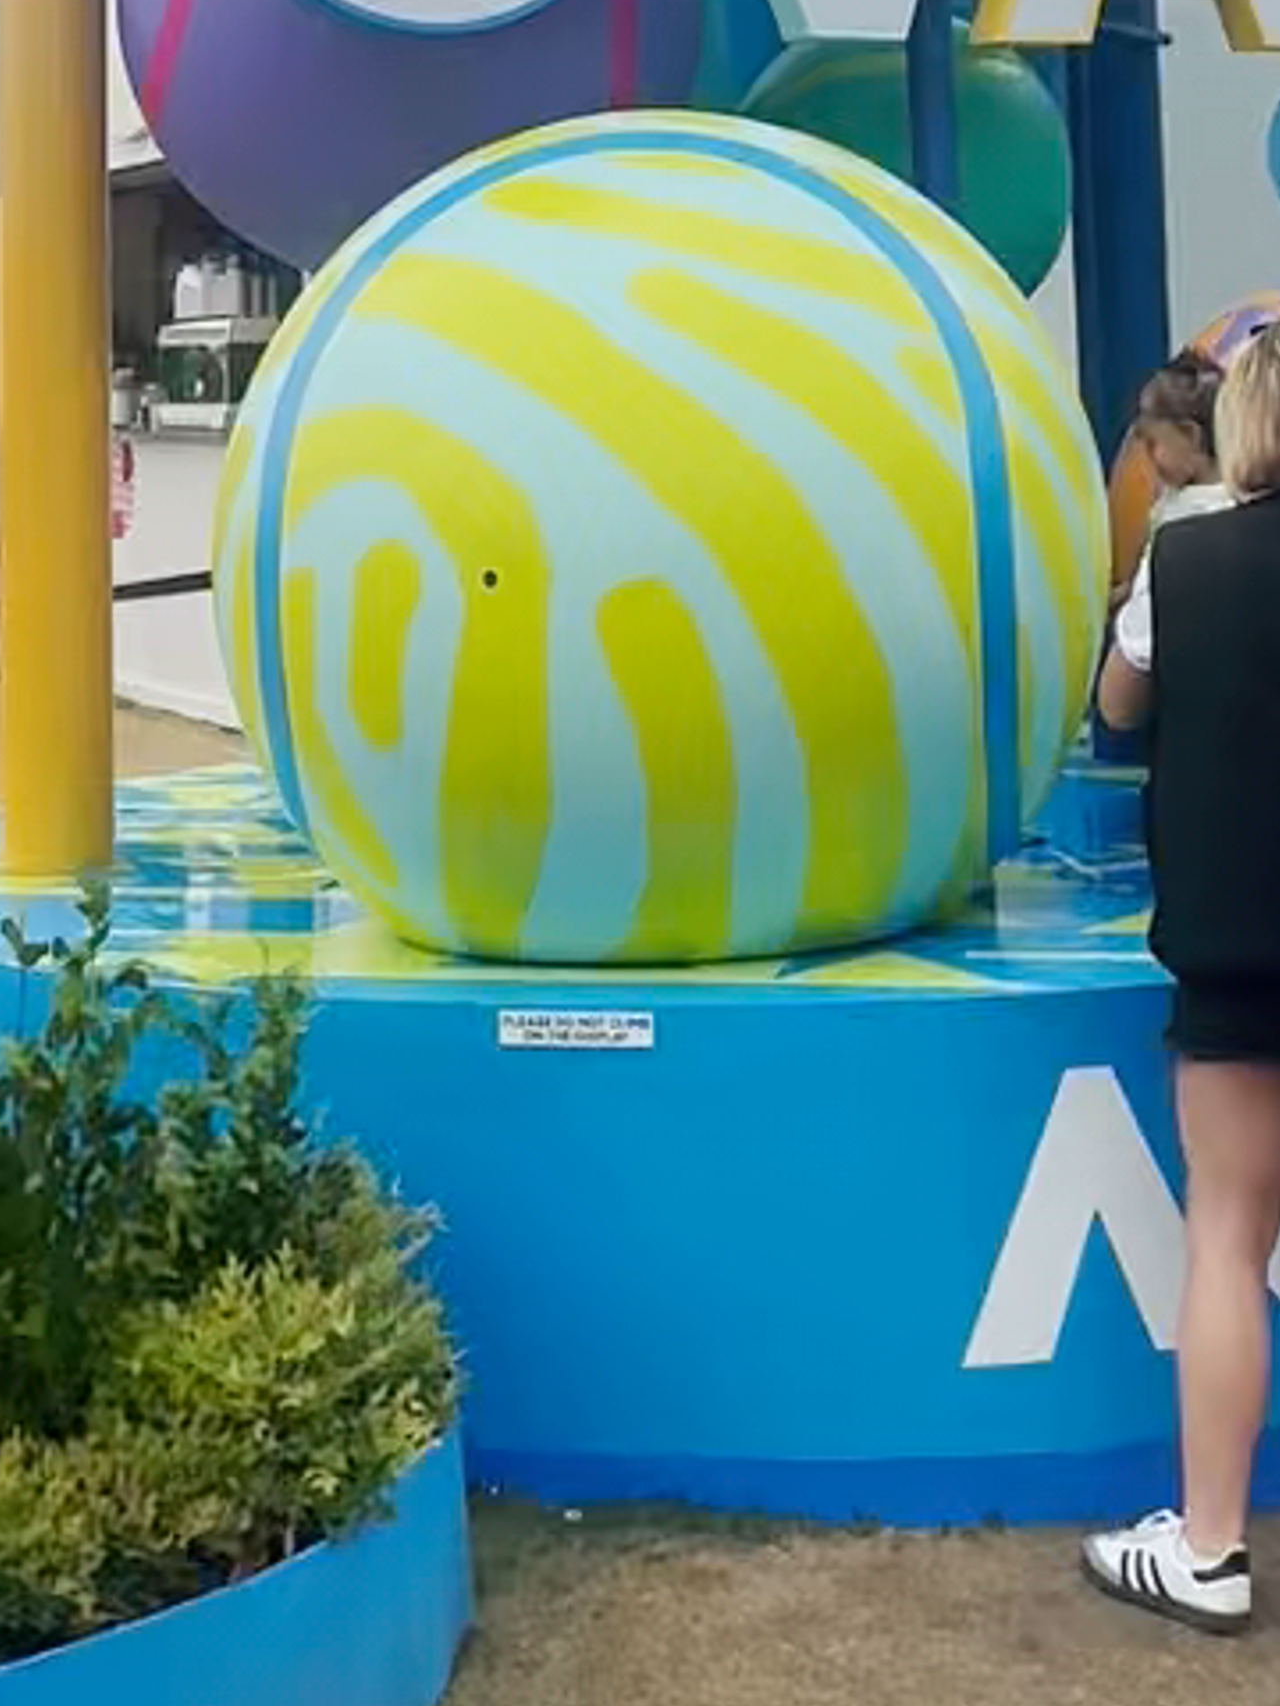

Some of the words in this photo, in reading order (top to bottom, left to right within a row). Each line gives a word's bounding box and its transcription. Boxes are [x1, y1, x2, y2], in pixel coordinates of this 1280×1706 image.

[503, 1014, 551, 1028] PLEASE
[556, 1014, 575, 1028] DO
[578, 1014, 604, 1028] NOT
[549, 1028, 569, 1041] THE
